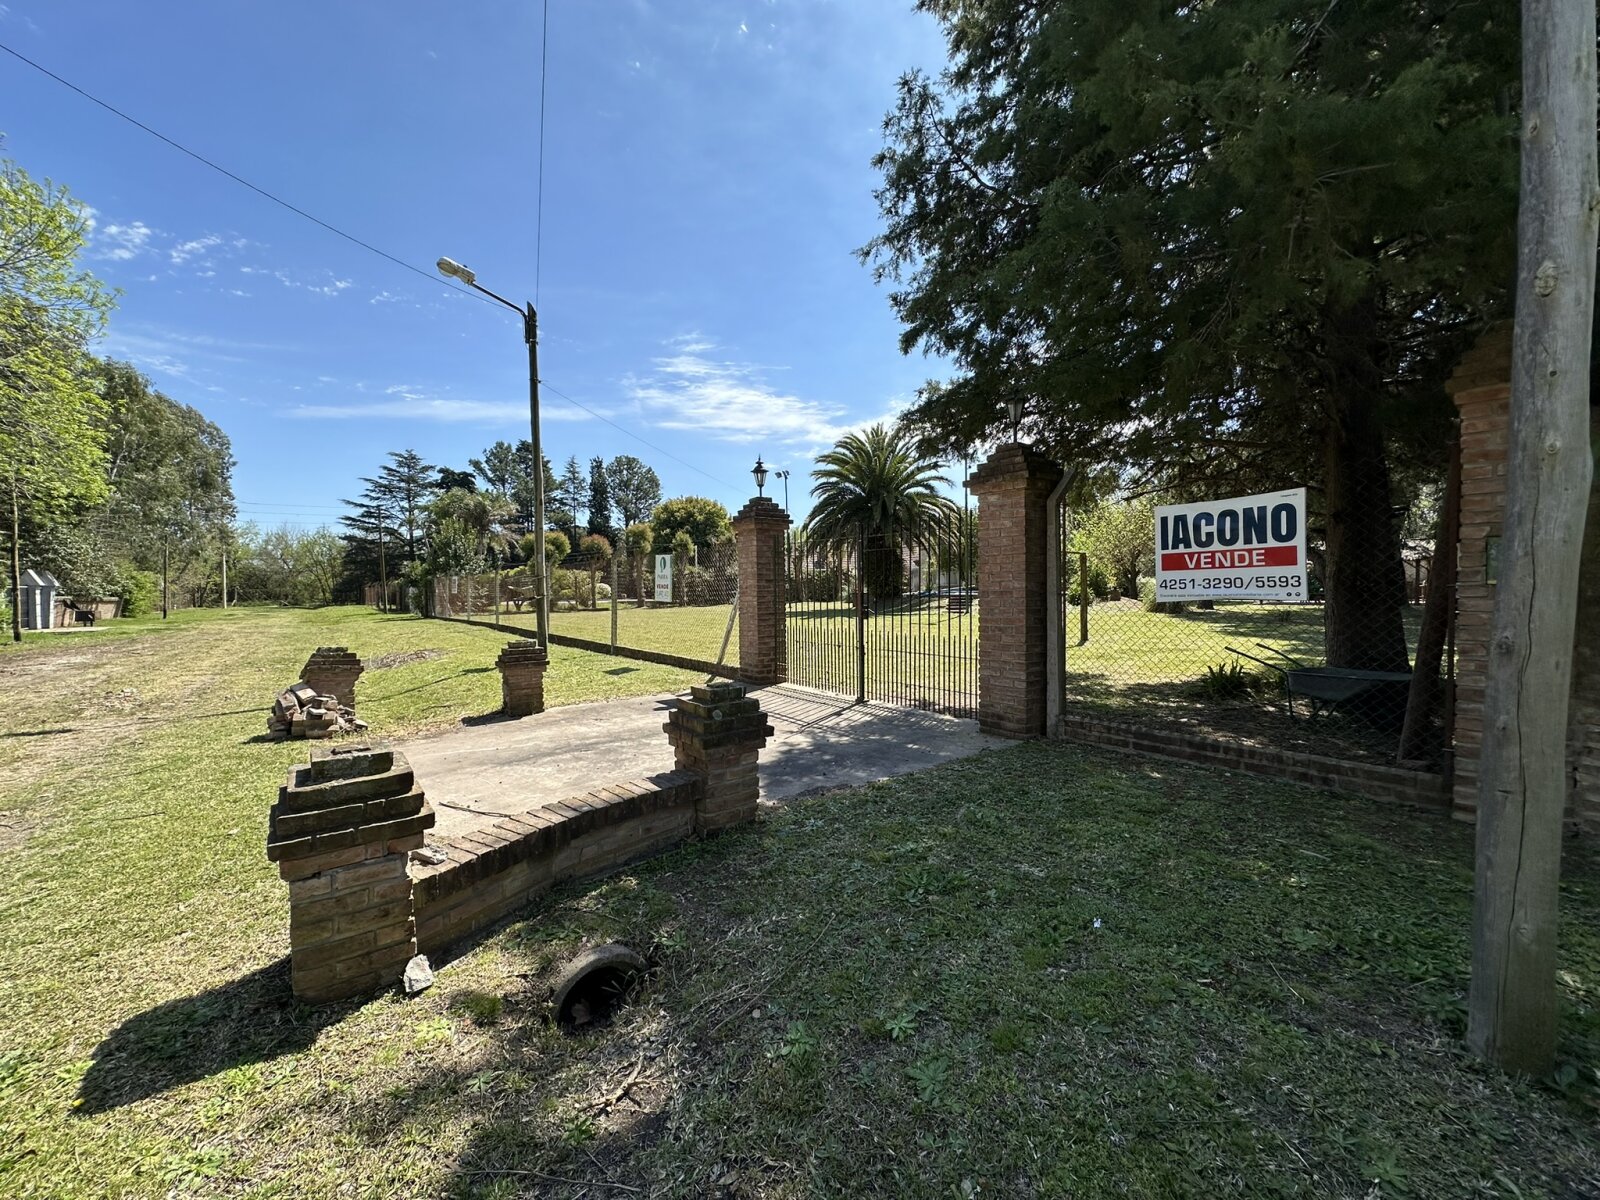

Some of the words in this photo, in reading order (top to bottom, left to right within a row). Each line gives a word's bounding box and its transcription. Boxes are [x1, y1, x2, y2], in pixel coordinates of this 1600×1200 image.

[1160, 502, 1297, 550] IACONO
[1184, 549, 1266, 569] VENDE
[1159, 575, 1302, 590] 4251-3290/5593
